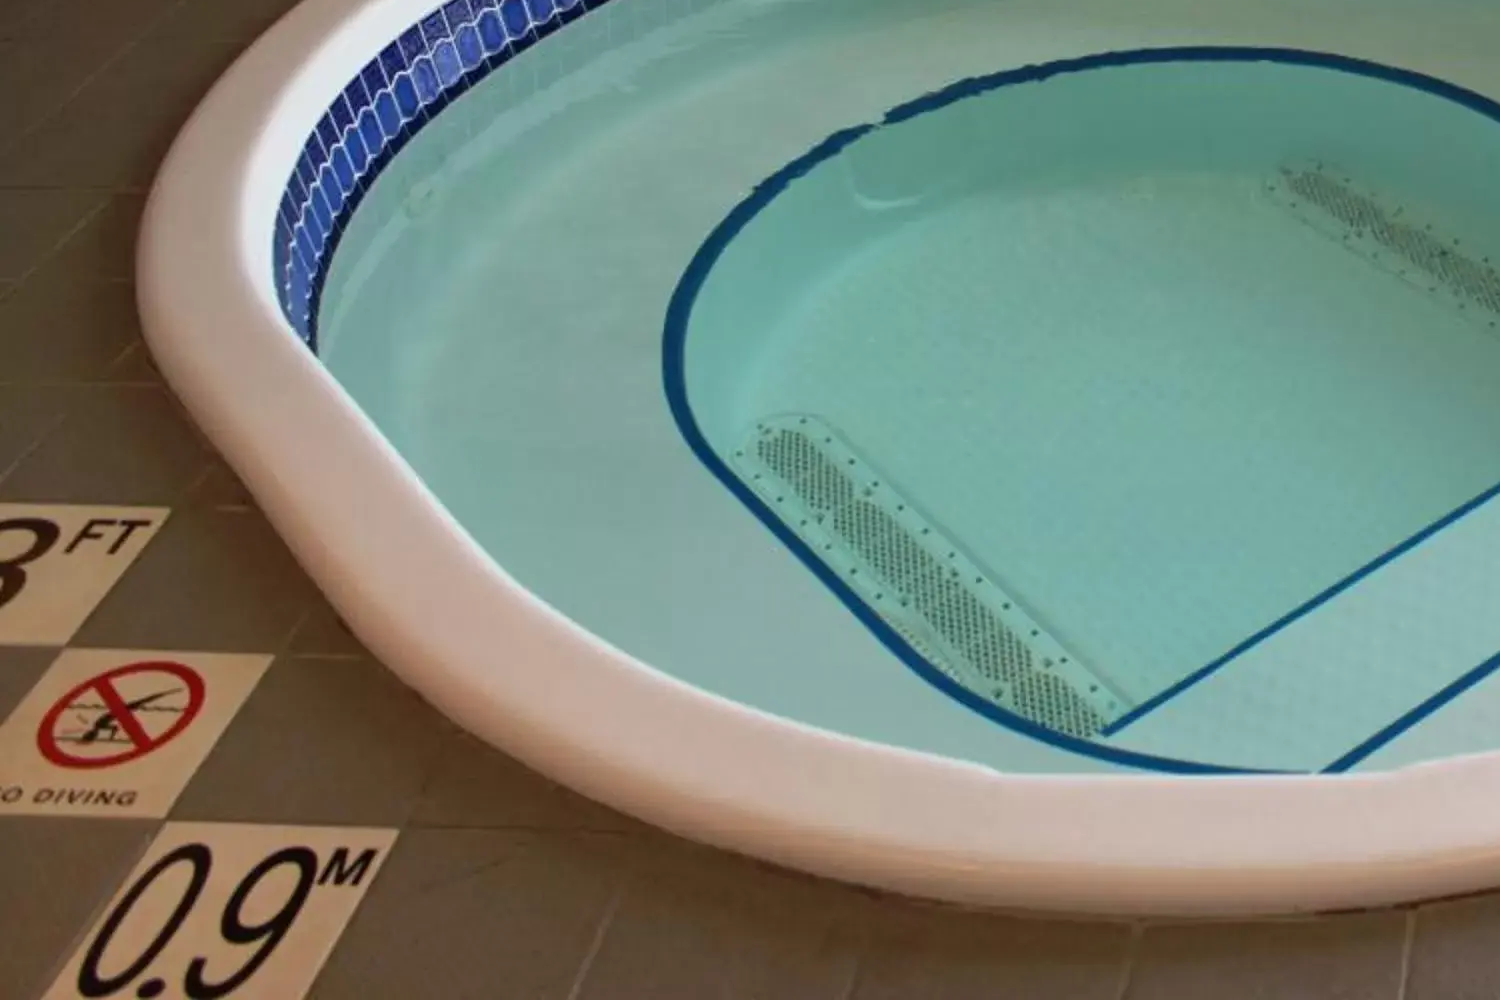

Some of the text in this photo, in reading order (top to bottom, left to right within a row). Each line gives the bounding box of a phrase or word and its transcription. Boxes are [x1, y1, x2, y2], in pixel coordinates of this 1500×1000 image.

[63, 518, 152, 555] FT
[0, 785, 138, 807] O DIVING
